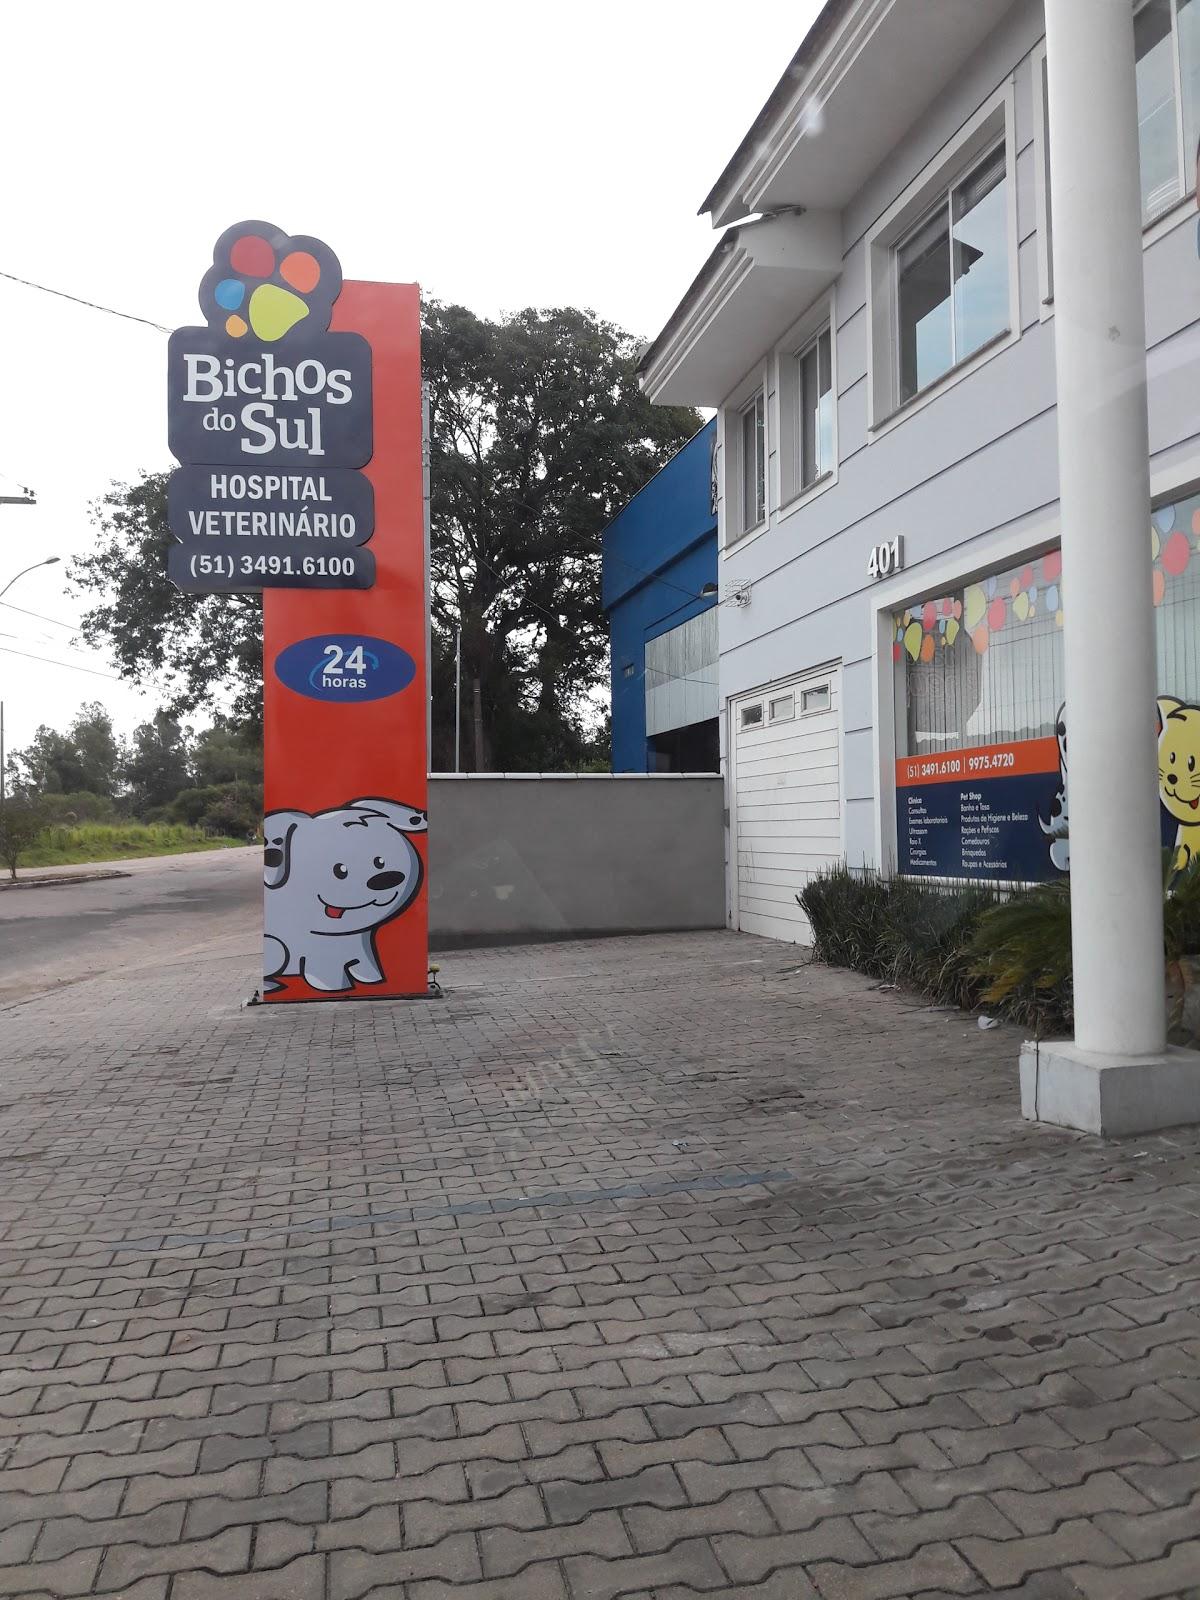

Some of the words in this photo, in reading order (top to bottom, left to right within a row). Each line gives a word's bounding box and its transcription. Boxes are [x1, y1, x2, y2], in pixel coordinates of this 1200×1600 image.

[183, 353, 352, 405] Bichos
[202, 407, 236, 432] do
[240, 402, 326, 456] Sul
[210, 474, 333, 501] HOSPITAL
[188, 506, 356, 538] VETERINÁRIO
[190, 554, 234, 578] (51)
[240, 555, 355, 576] 3491.6100
[867, 535, 904, 578] 401
[323, 645, 367, 675] 24
[322, 675, 367, 689] horas
[907, 764, 920, 779] (51)
[921, 760, 961, 776] 3491.6100
[968, 752, 1015, 771] 9975.4720
[969, 792, 982, 801] Shop
[988, 813, 1006, 823] Higiene
[1012, 812, 1028, 820] Beleza
[961, 837, 990, 845] Comedouros
[961, 848, 986, 857] Brinquedos
